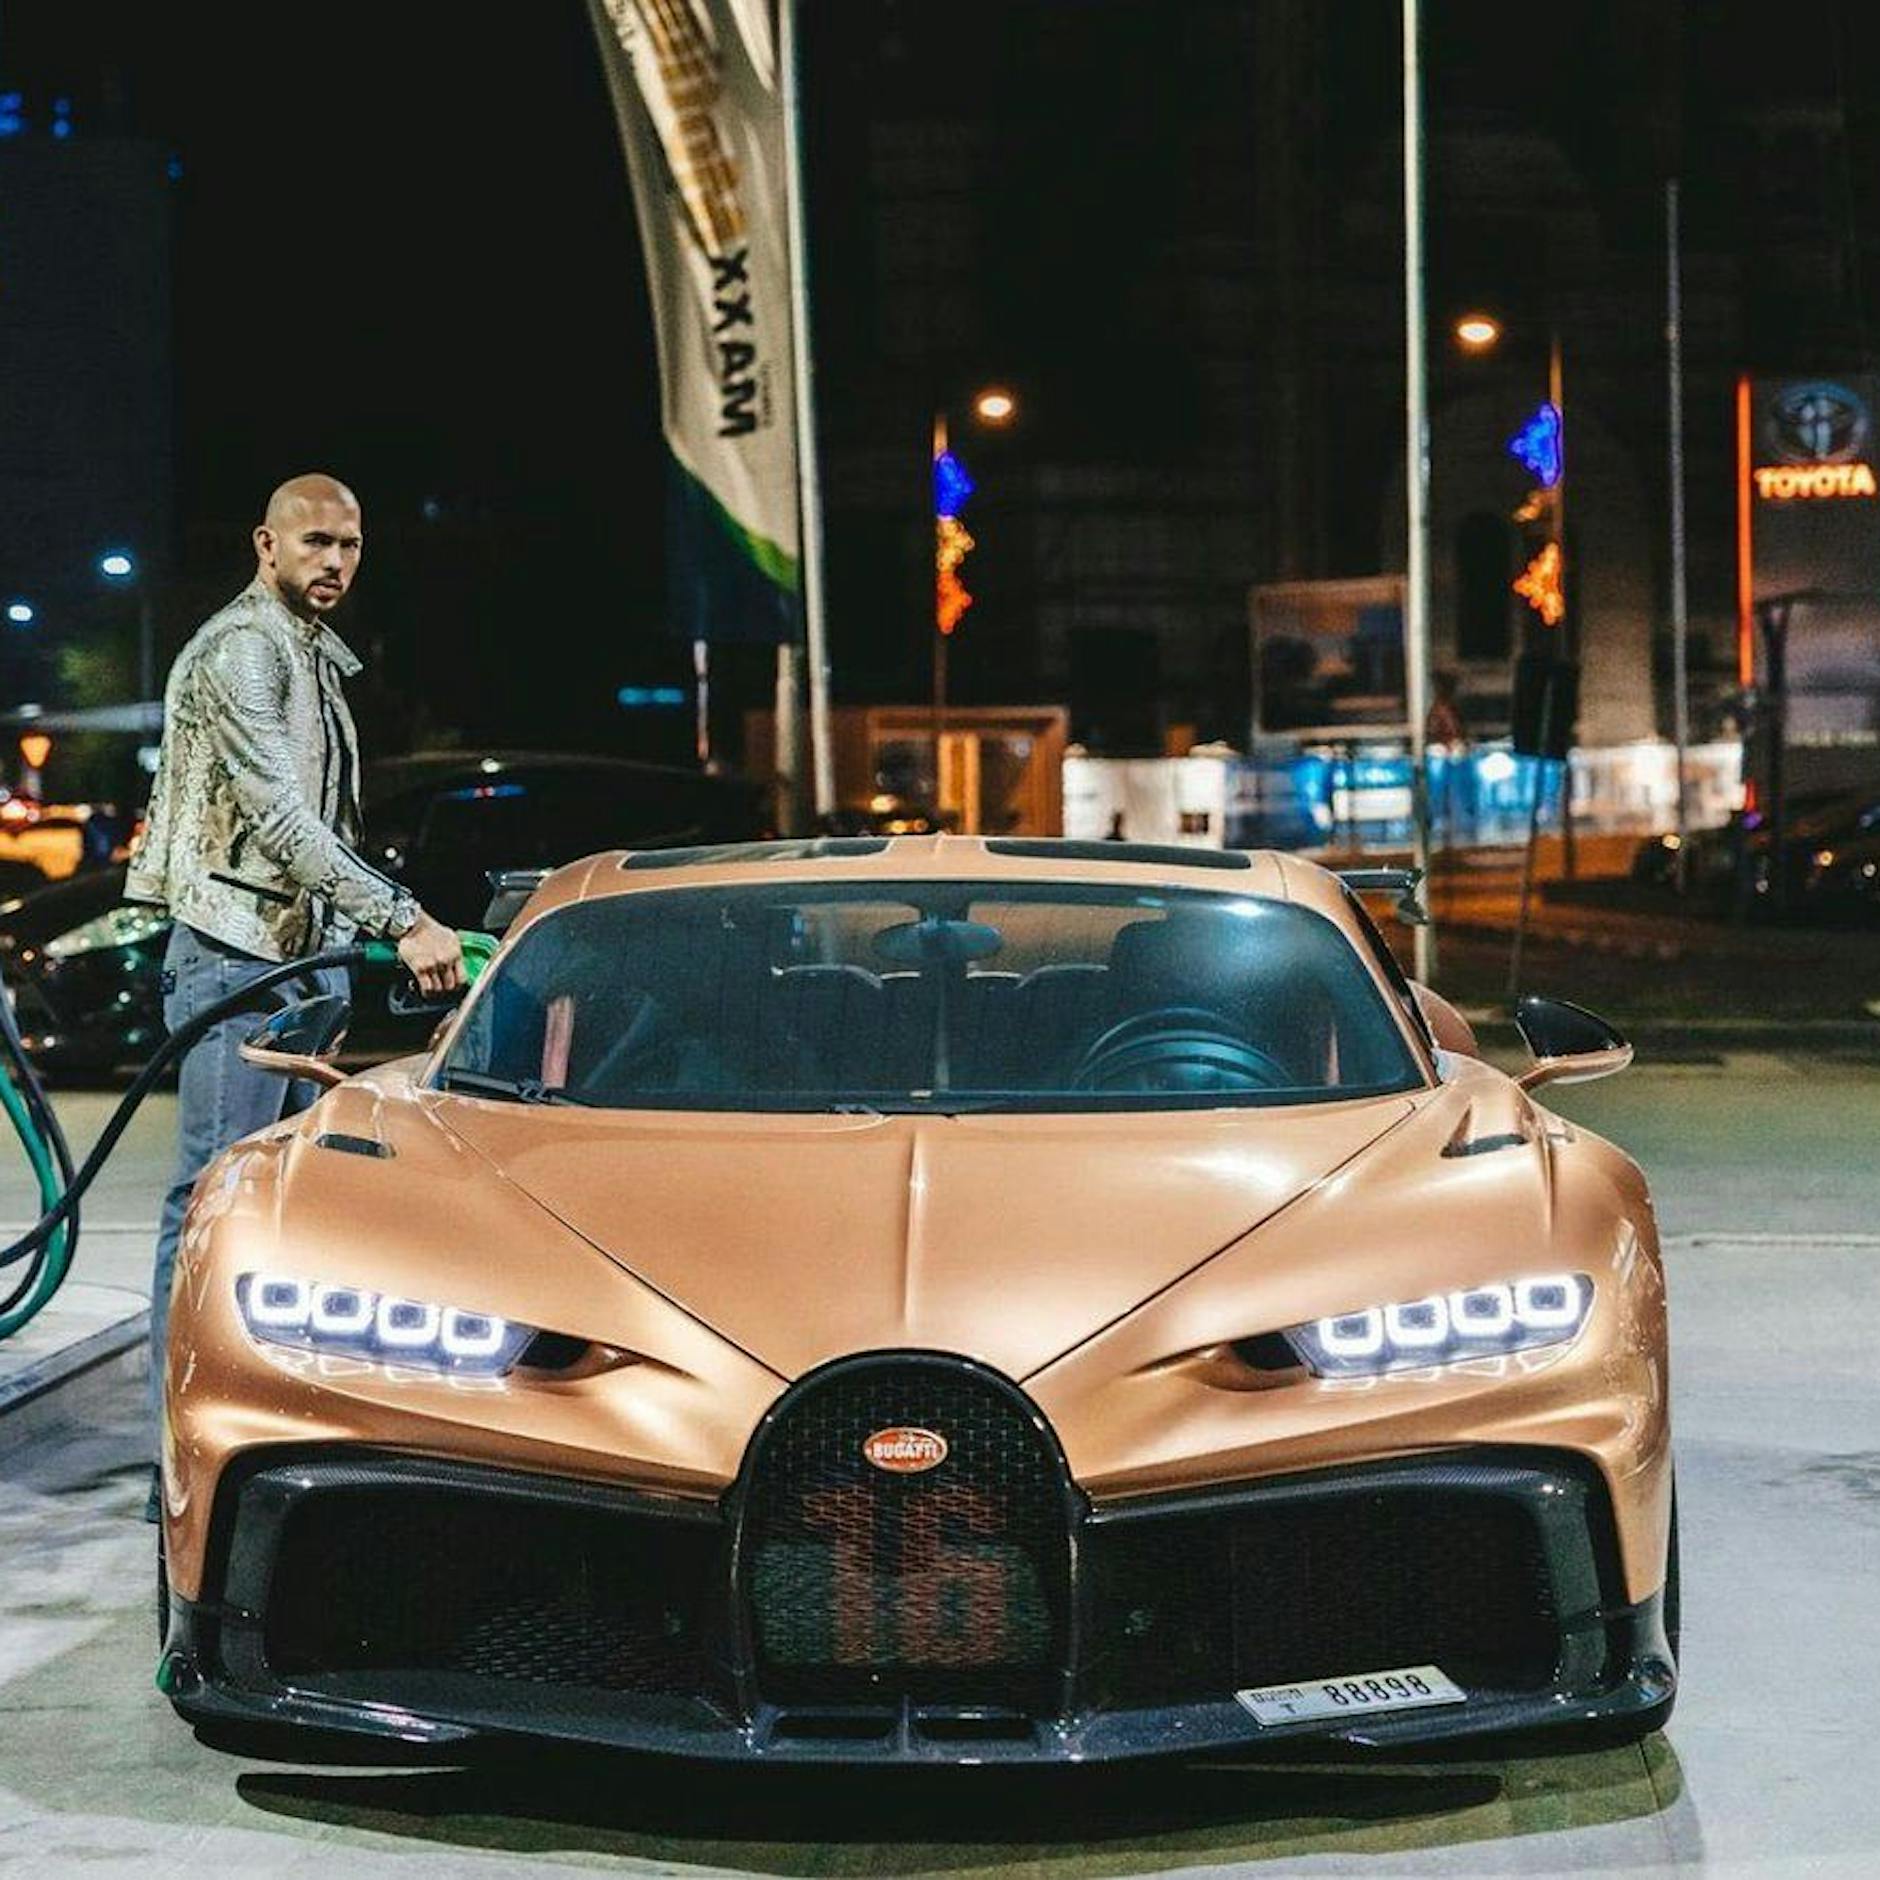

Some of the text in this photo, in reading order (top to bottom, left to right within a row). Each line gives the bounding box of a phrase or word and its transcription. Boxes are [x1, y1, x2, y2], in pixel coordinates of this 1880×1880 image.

[1754, 463, 1876, 498] TOYOTA
[872, 1440, 938, 1460] BUGATTI
[801, 1486, 1006, 1663] 16
[1323, 1674, 1431, 1706] 88898
